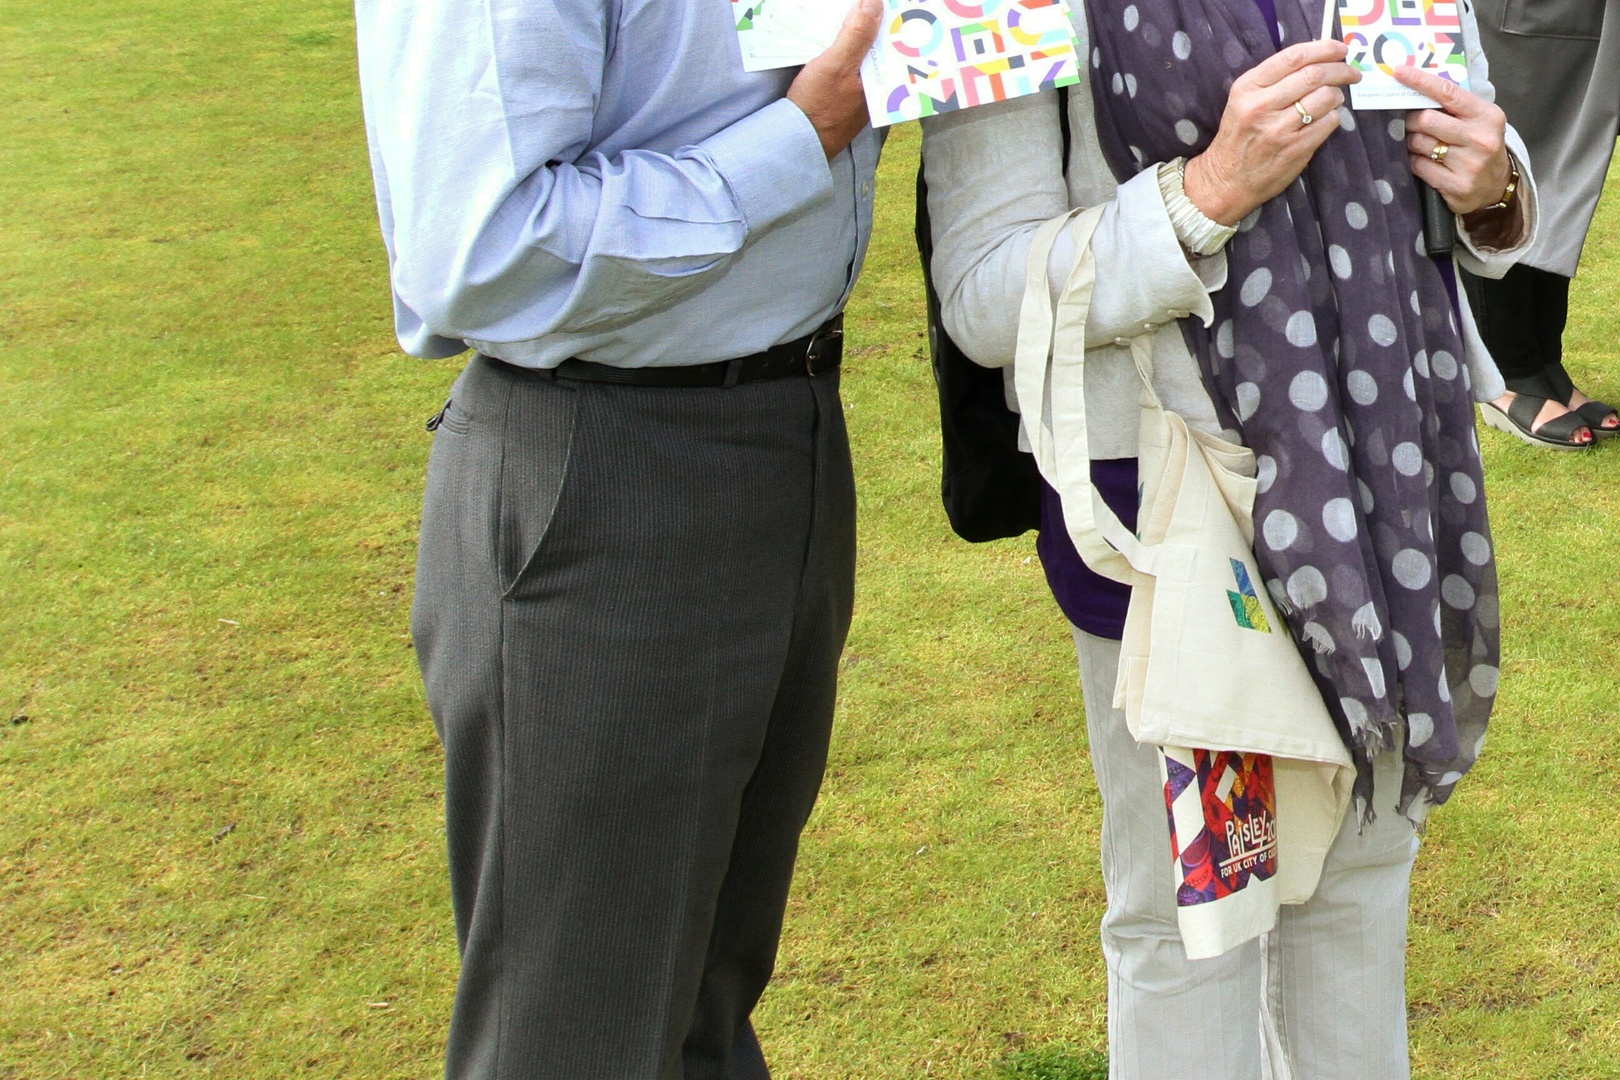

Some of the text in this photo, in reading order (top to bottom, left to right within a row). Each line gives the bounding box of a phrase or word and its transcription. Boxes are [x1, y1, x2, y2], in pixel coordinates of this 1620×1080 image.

[1221, 866, 1233, 879] FOR
[1233, 862, 1243, 873] UK
[1243, 855, 1258, 869] CITY
[1259, 852, 1267, 863] OF
